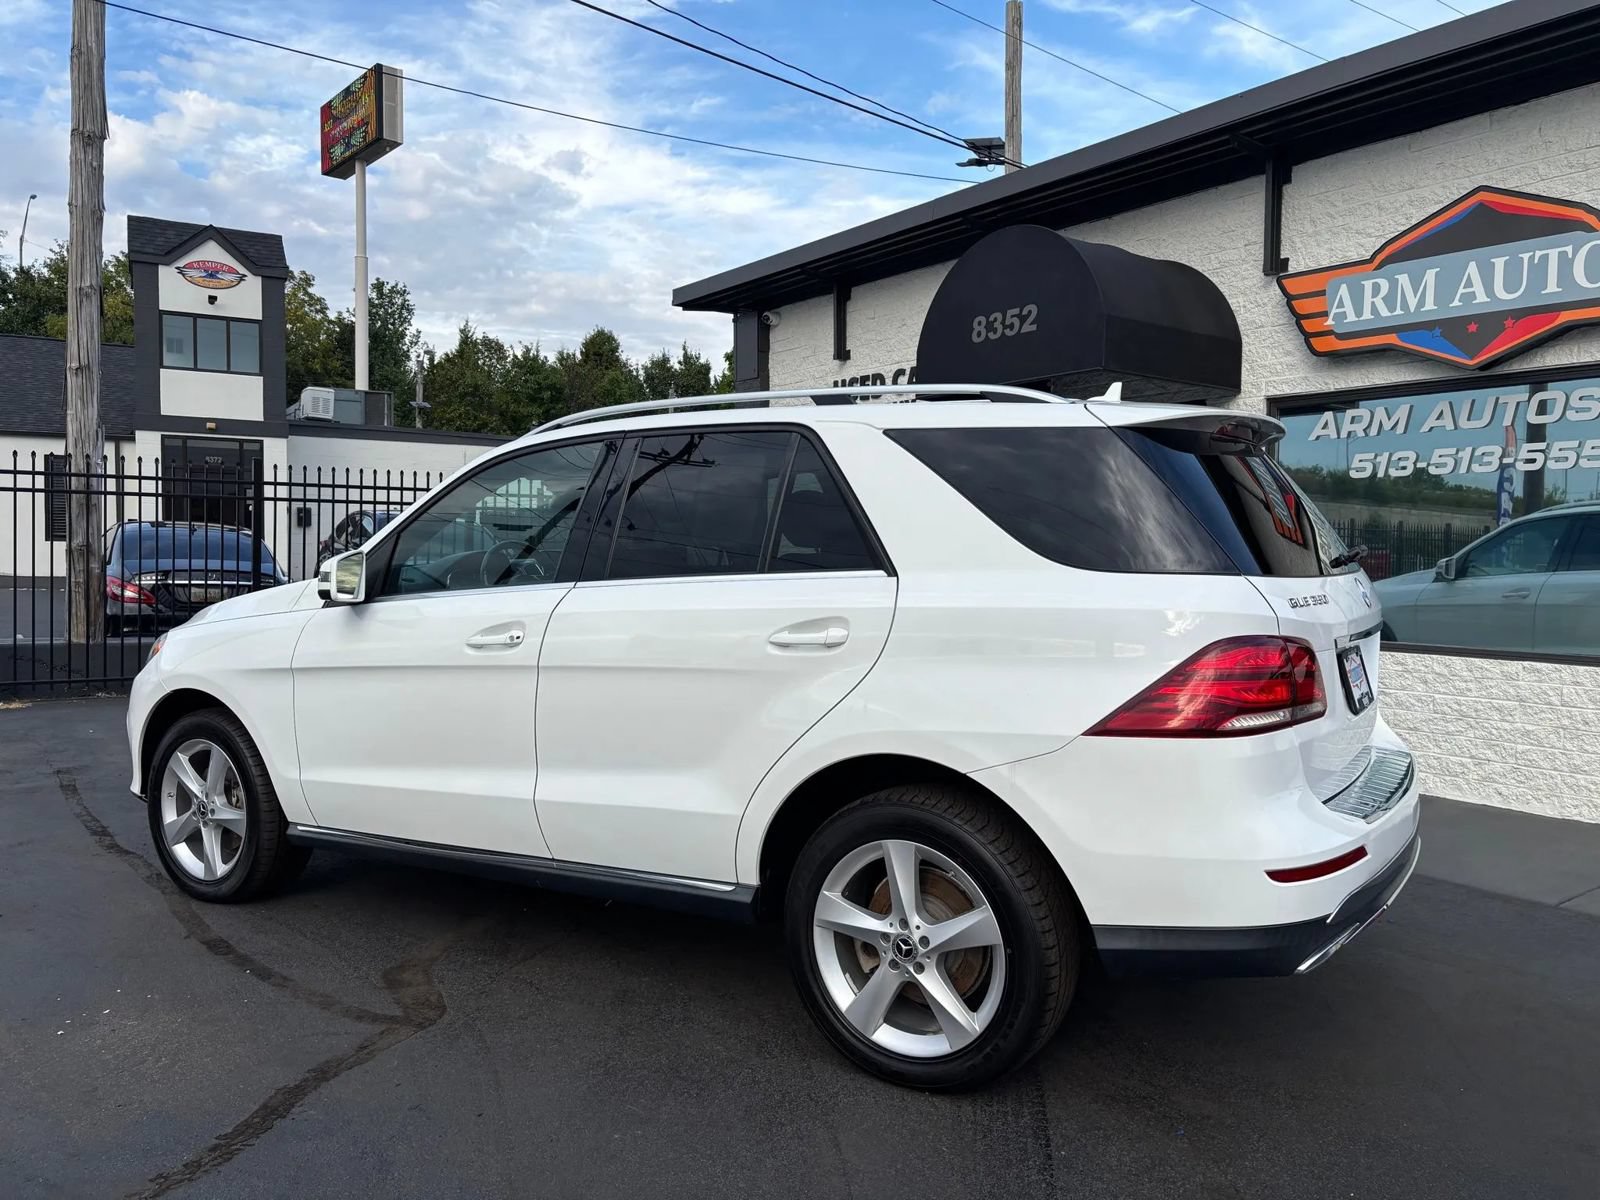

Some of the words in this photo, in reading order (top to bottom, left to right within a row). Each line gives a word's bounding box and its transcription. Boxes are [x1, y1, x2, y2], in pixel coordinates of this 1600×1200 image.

[192, 261, 229, 272] KEMPER
[1323, 267, 1441, 326] ARM
[1449, 240, 1600, 308] AUTO
[970, 303, 1039, 344] 8352
[1307, 402, 1414, 442] ARM
[1418, 386, 1600, 434] AUTOS
[1348, 438, 1600, 480] 513-513-555
